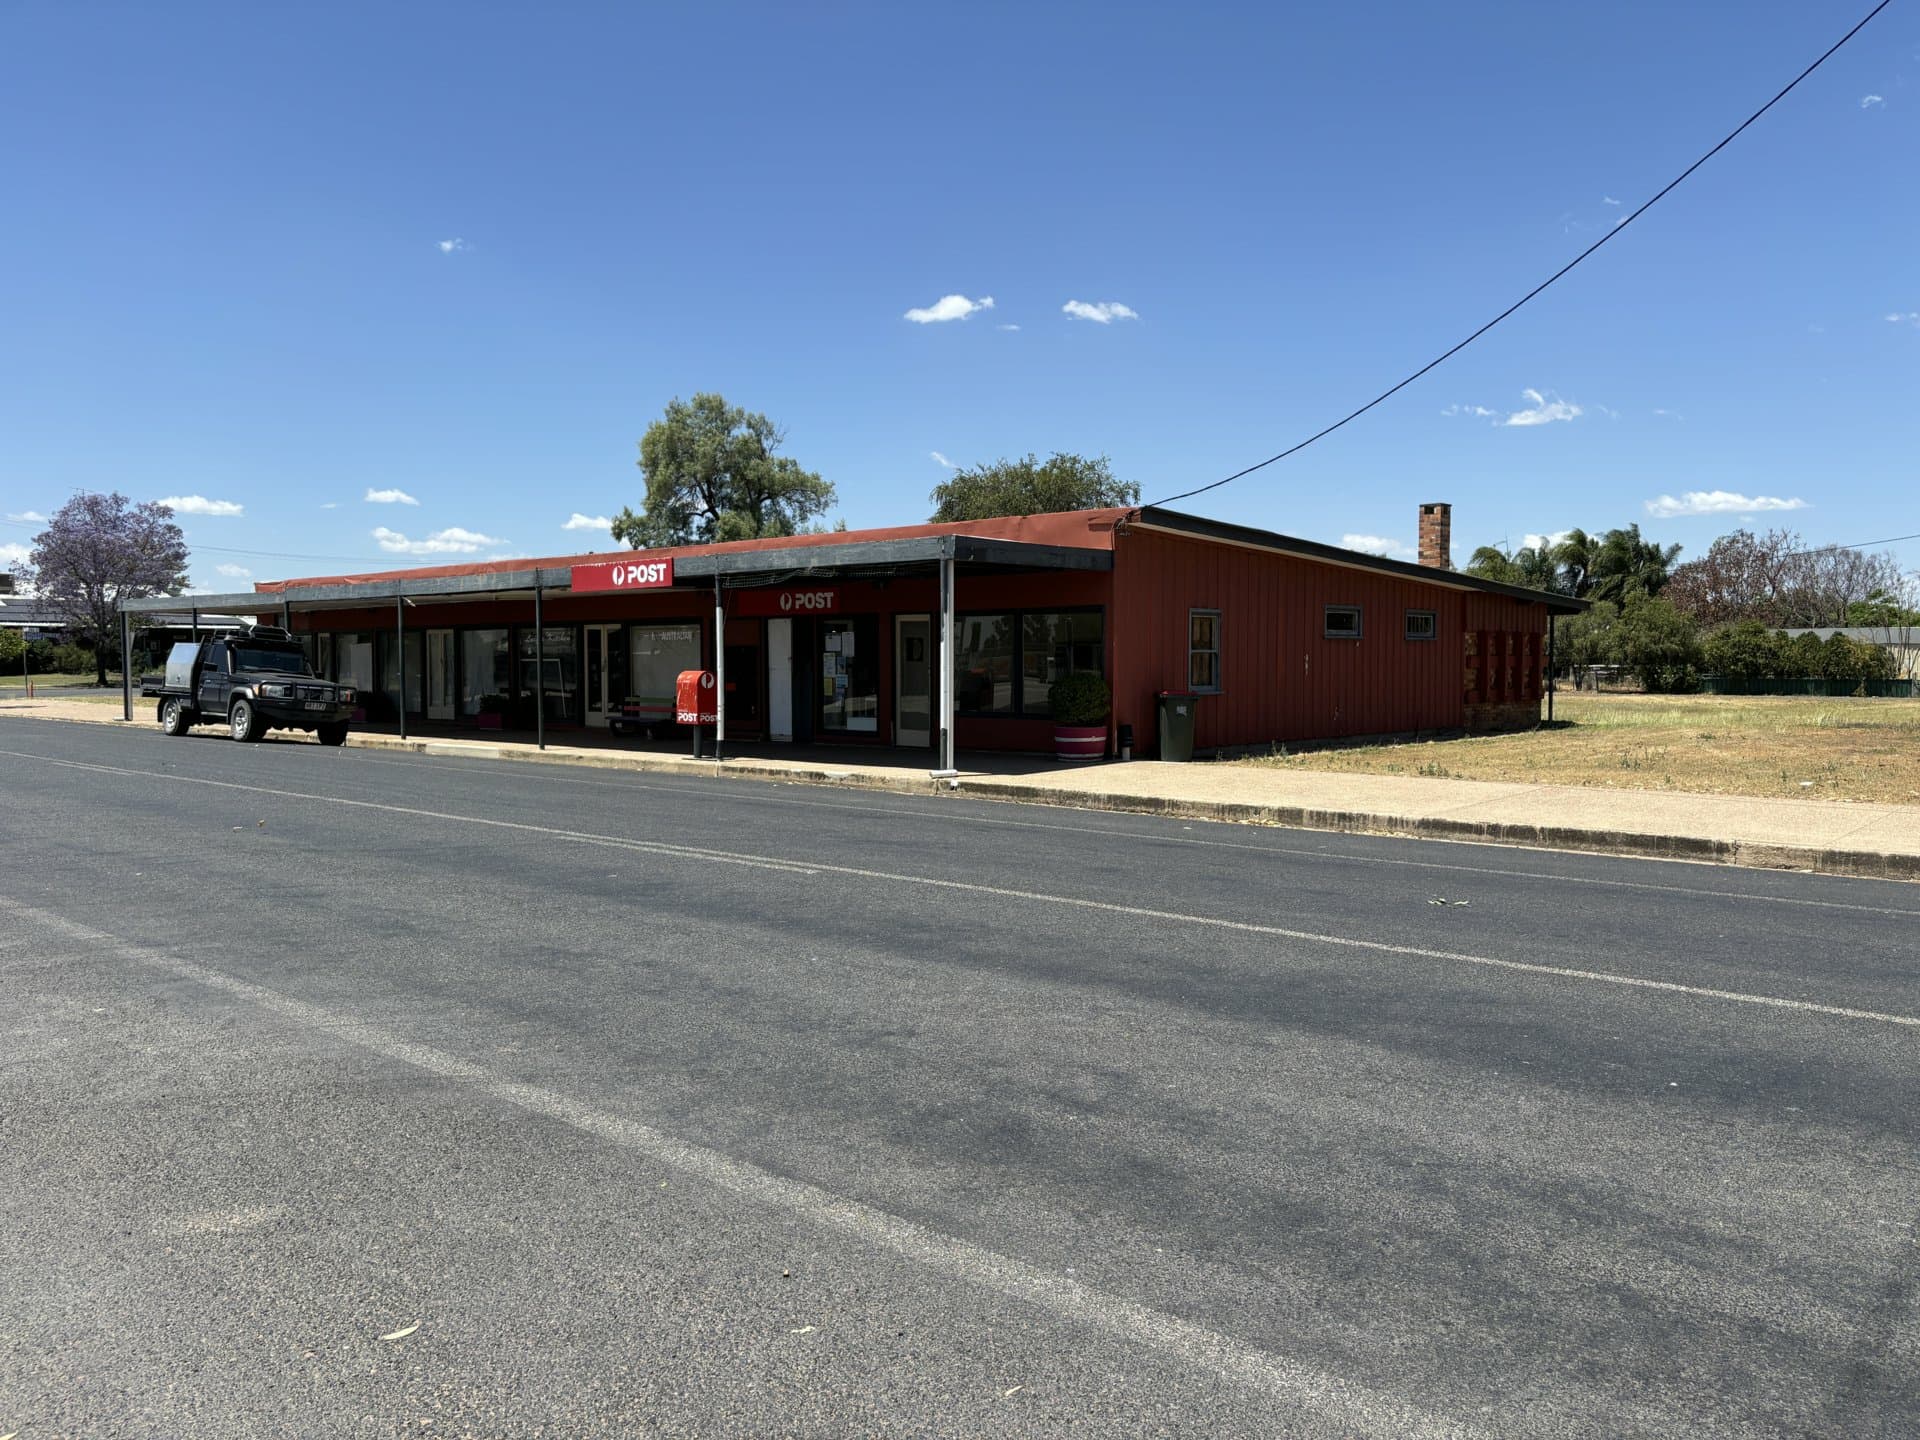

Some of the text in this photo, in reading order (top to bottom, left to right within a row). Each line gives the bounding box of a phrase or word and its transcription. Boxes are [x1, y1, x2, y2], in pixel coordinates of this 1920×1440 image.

[627, 563, 667, 584] POST
[795, 592, 834, 609] POST
[678, 712, 698, 722] POST
